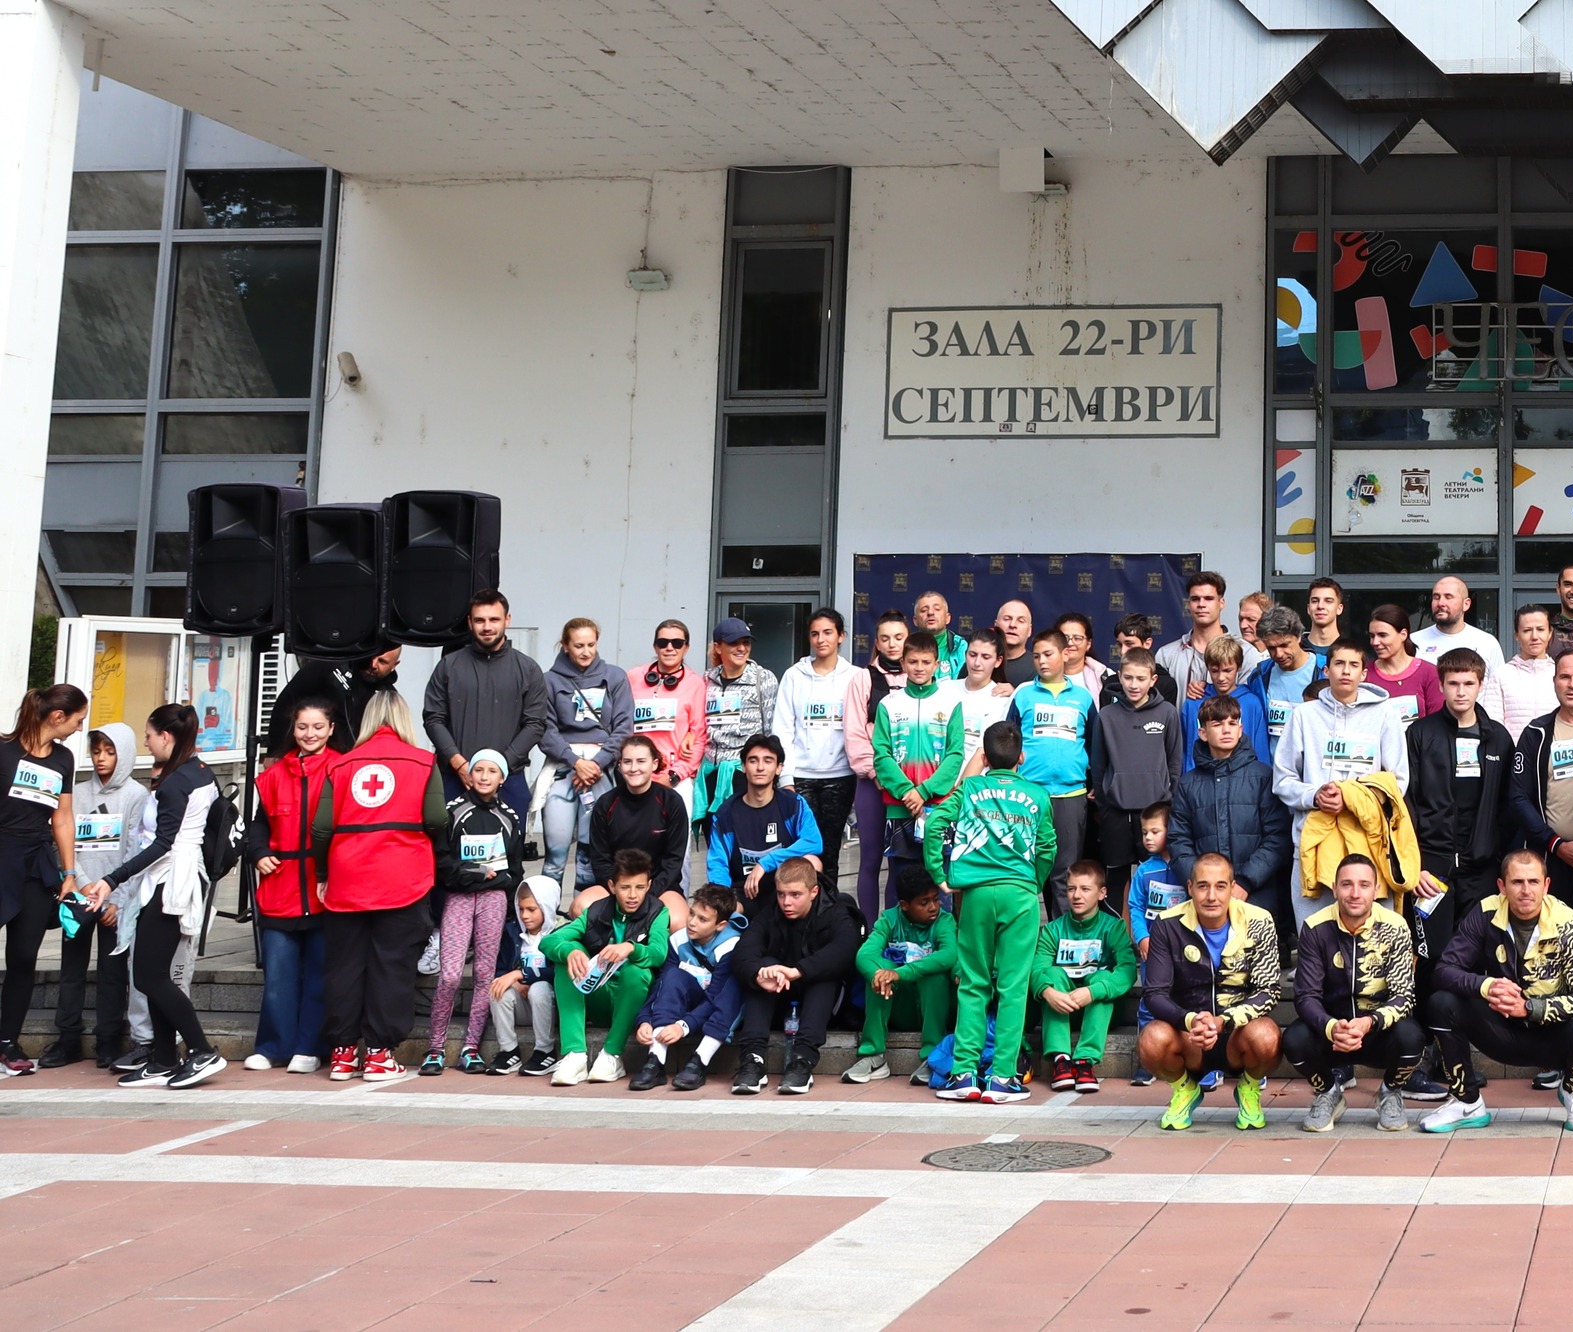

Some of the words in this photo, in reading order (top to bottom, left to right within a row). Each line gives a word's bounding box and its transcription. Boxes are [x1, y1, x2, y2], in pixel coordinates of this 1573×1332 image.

[912, 320, 1035, 357] ЗАЛА
[1058, 318, 1198, 356] 22-РИ
[891, 385, 1216, 425] СЕПТЕМВРИ
[635, 707, 652, 718] 076
[1036, 712, 1054, 723] 091
[1269, 708, 1286, 722] 064
[1327, 740, 1346, 754] 041
[19, 771, 38, 785] 109
[970, 788, 1006, 805] PIRIN
[1008, 789, 1039, 814] 1970
[77, 824, 92, 836] 110
[463, 845, 485, 857] 006
[1060, 949, 1075, 961] 114
[581, 974, 600, 992] 081
